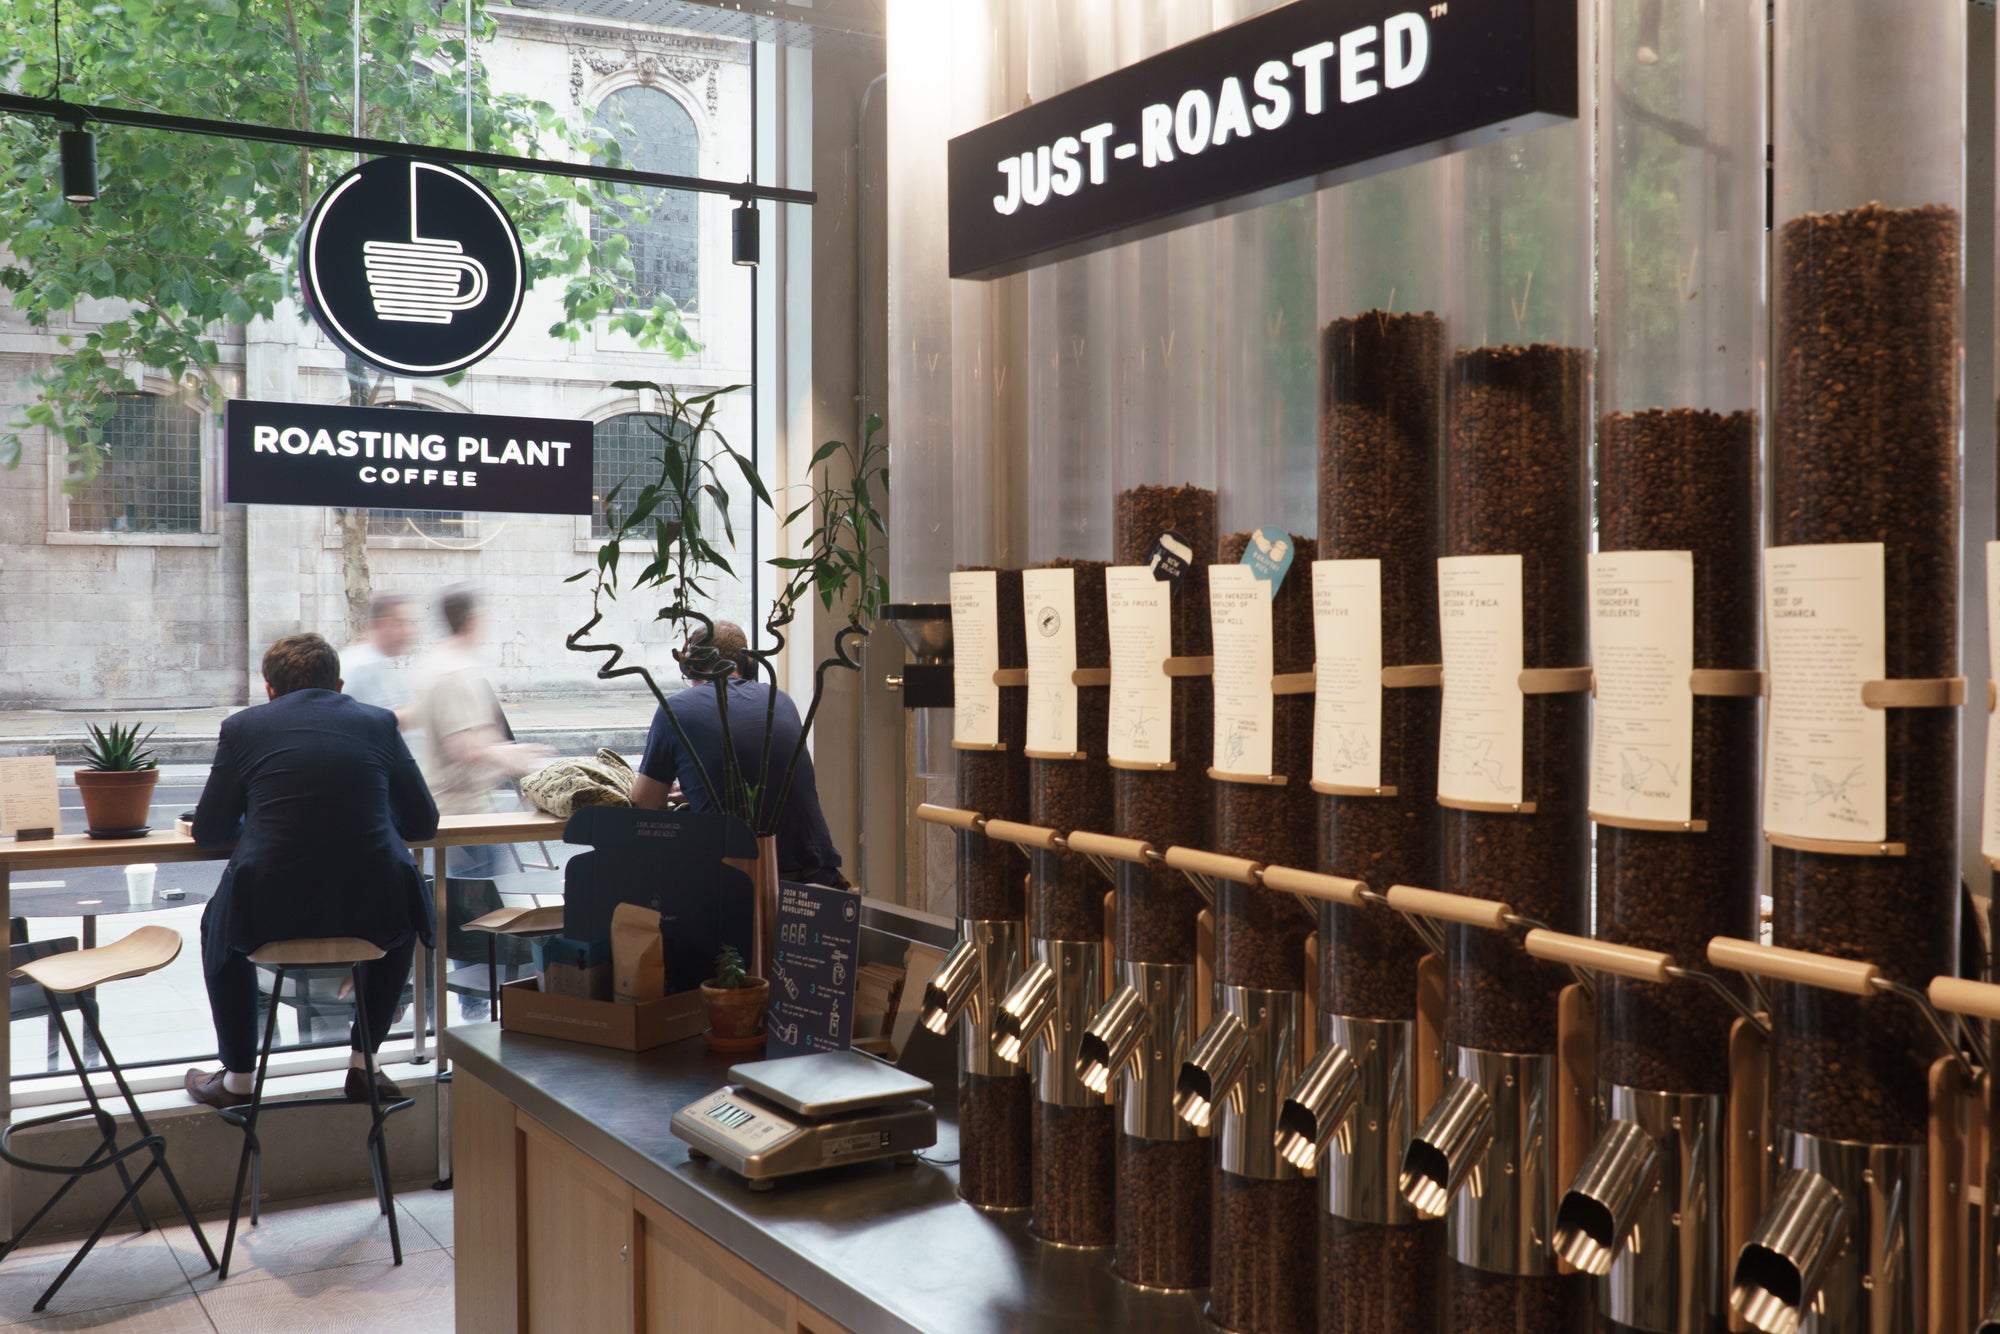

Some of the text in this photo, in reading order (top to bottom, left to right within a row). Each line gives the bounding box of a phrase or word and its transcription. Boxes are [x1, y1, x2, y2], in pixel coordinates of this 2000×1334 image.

[993, 12, 1430, 215] JUST-ROASTED
[253, 425, 571, 467] ROASTING PLANT
[359, 466, 477, 487] COFFEE
[1167, 556, 1180, 568] NEW
[1161, 561, 1181, 577] ORIGIN
[1469, 599, 1498, 607] FINCA
[1792, 597, 1803, 607] OF
[783, 888, 808, 899] JOIN THE
[782, 896, 821, 910] JUST-ROASTED
[782, 905, 816, 917] REVOLUTION!
[814, 931, 820, 944] 1
[778, 950, 784, 961] 2
[810, 983, 816, 994] 3
[775, 1000, 781, 1011] 4
[806, 1034, 812, 1046] 5
